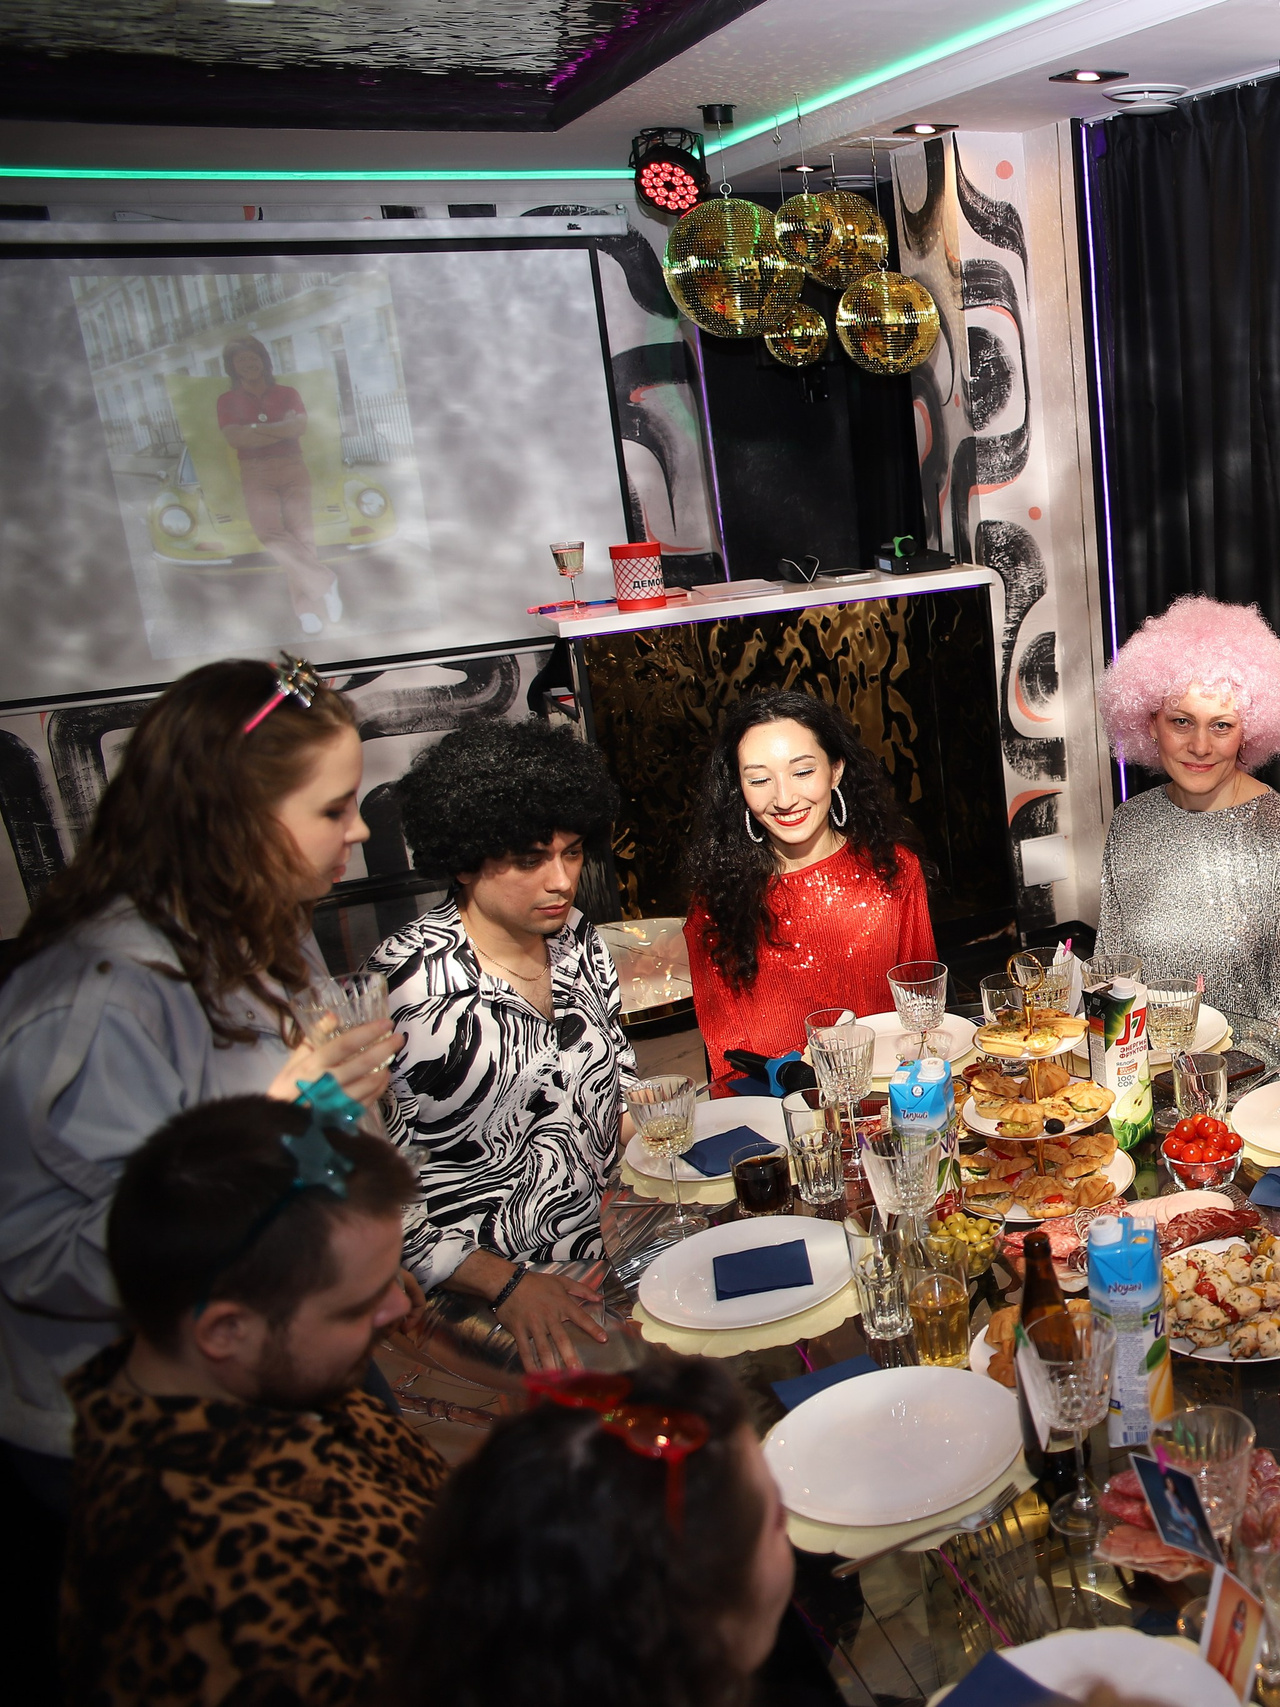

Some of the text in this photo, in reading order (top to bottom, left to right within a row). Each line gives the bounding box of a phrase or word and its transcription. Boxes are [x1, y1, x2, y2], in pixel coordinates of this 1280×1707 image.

[1115, 1007, 1147, 1046] J7
[1119, 1046, 1148, 1059] ФРУКТОВ
[1120, 1038, 1147, 1053] ЭНЕРГИЯ
[1117, 1080, 1134, 1088] СОК
